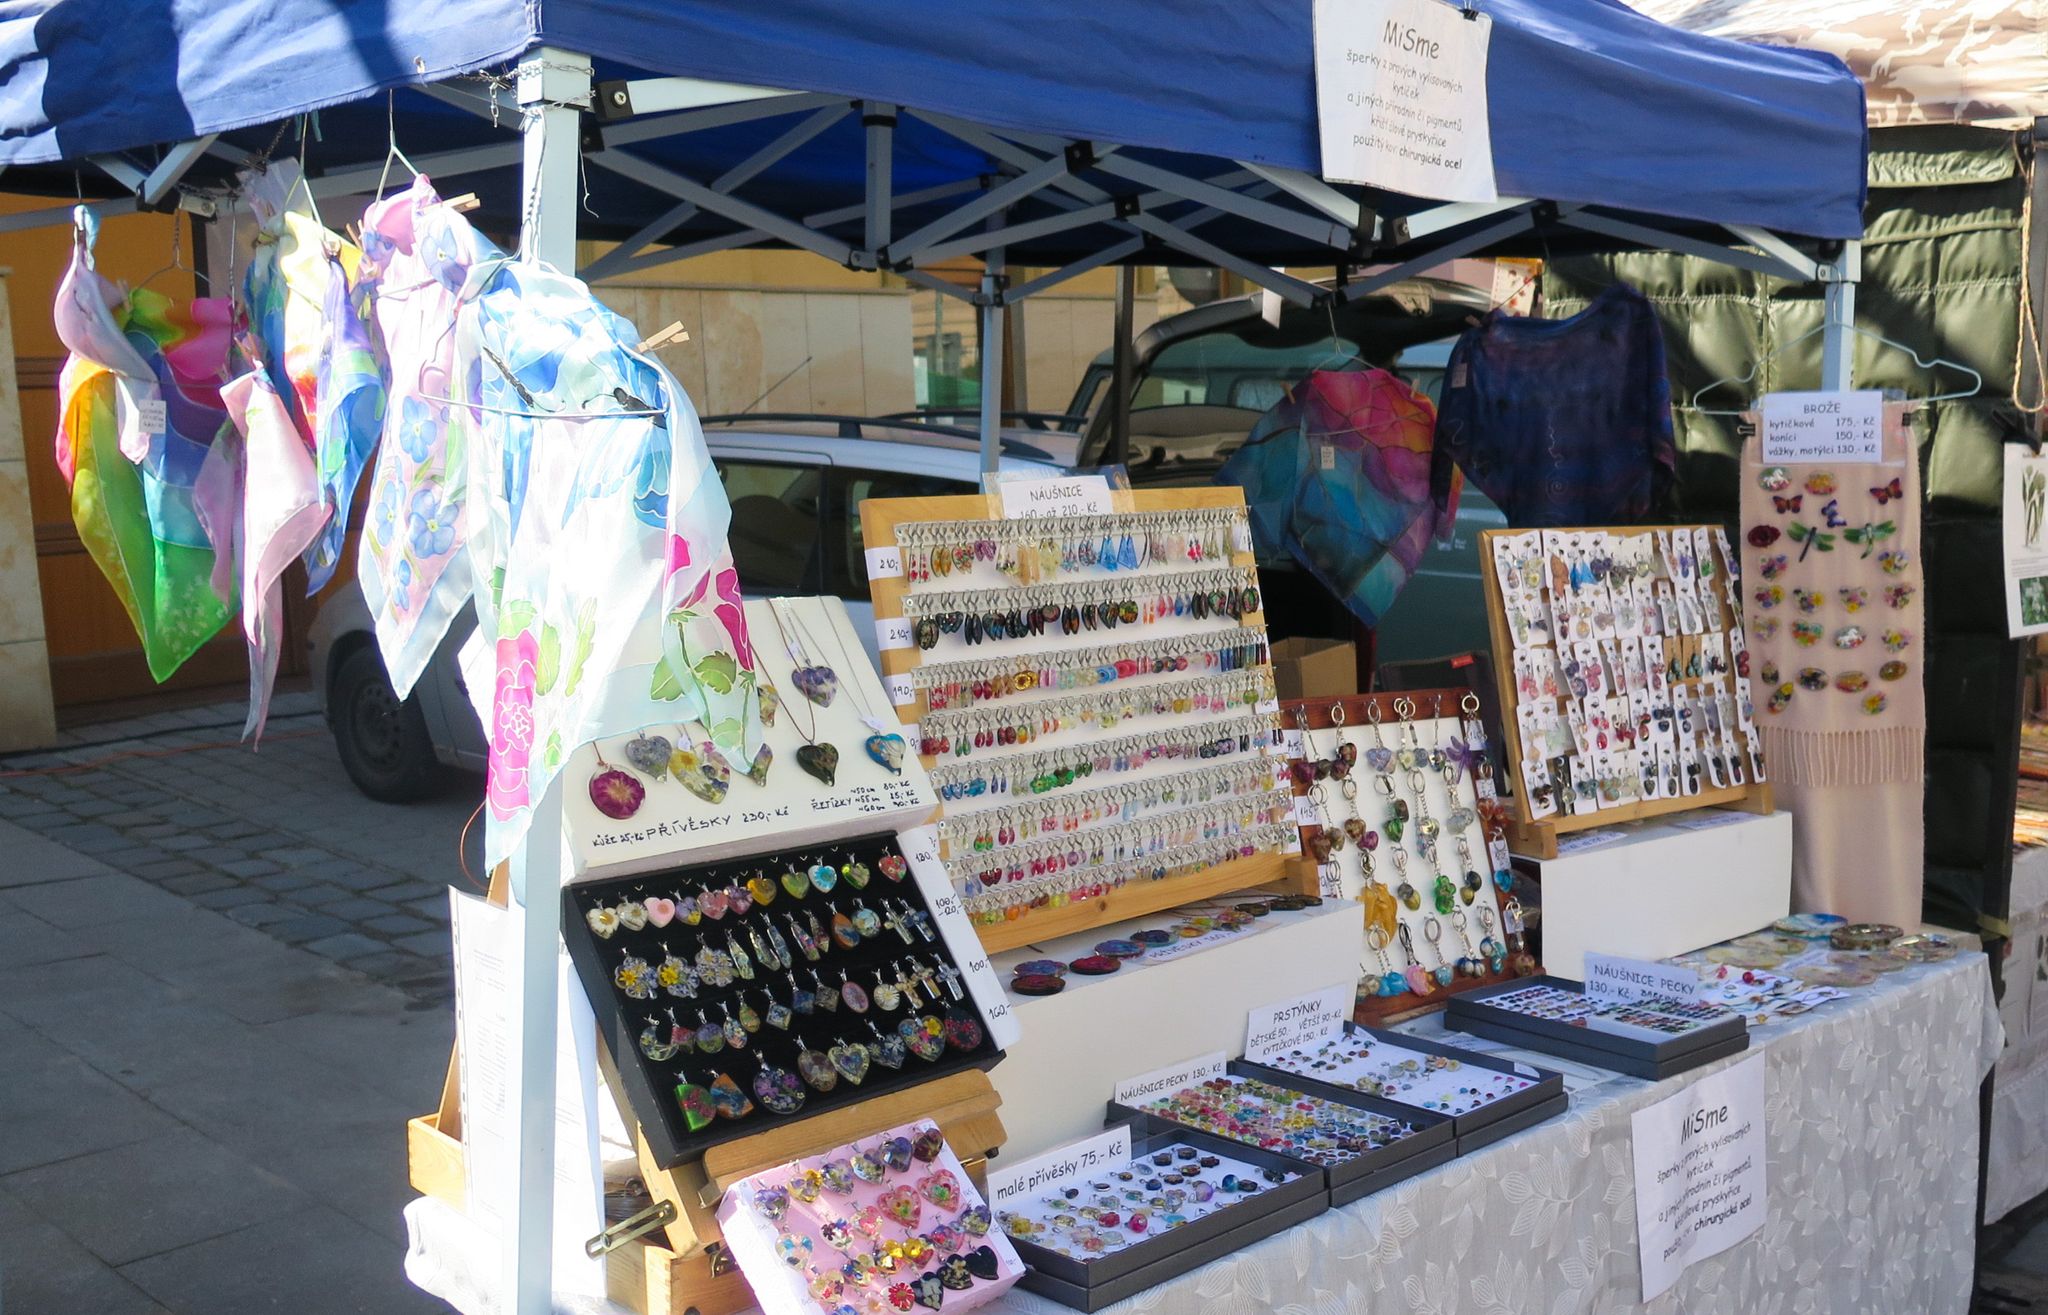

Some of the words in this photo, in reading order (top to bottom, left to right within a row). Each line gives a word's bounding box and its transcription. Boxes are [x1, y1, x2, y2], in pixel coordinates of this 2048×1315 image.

[1383, 19, 1440, 59] MiSme
[1346, 49, 1381, 69] šperky
[1388, 62, 1416, 79] pravých
[1419, 72, 1462, 94] vylisovaných
[1348, 93, 1353, 101] a
[1356, 92, 1384, 108] jiných
[1393, 80, 1419, 100] kytiček
[1406, 130, 1447, 147] pryskyřice
[1399, 145, 1441, 166] chirurgická
[1444, 157, 1462, 169] ocel
[1803, 401, 1841, 414] BROŽE
[1769, 418, 1815, 430] kytičkové
[1836, 417, 1860, 428] 175,-
[1863, 416, 1875, 426] Kč
[1769, 431, 1797, 442] koníci
[1836, 431, 1860, 441] 150,-
[1863, 429, 1875, 440] Kč
[1800, 445, 1835, 456] motýlci
[1837, 445, 1862, 455] 130,-
[1864, 443, 1877, 453] Kč
[1030, 484, 1083, 501] NÁUŠNICE
[1087, 501, 1098, 514] Kč
[811, 797, 851, 811] ŘETÍZKY
[646, 815, 731, 840] PŘÍVĚSKY
[776, 807, 790, 817] Kč
[1590, 980, 1615, 996] 130,-
[1594, 963, 1654, 988] NÁUŠNICE
[1660, 978, 1695, 996] PECKY
[1273, 999, 1322, 1025] PRSTÝNKY
[1250, 1026, 1277, 1048] DĚTSKÉ
[1299, 1014, 1320, 1031] VĚTŠÍ
[1263, 1032, 1301, 1056] KYTIČKOVÉ
[1320, 1025, 1328, 1037] Kč
[1120, 1079, 1165, 1102] NÁUŠNICE
[1165, 1072, 1189, 1088] PECKY
[1212, 1062, 1222, 1073] Kč
[1681, 1105, 1728, 1145] MiSme
[997, 1176, 1025, 1200] malé
[1029, 1160, 1078, 1192] přívěsky
[1080, 1151, 1105, 1169] 75,-
[1109, 1140, 1122, 1158] Kč
[1694, 1202, 1738, 1231] chirurgická
[1740, 1192, 1752, 1210] ocel
